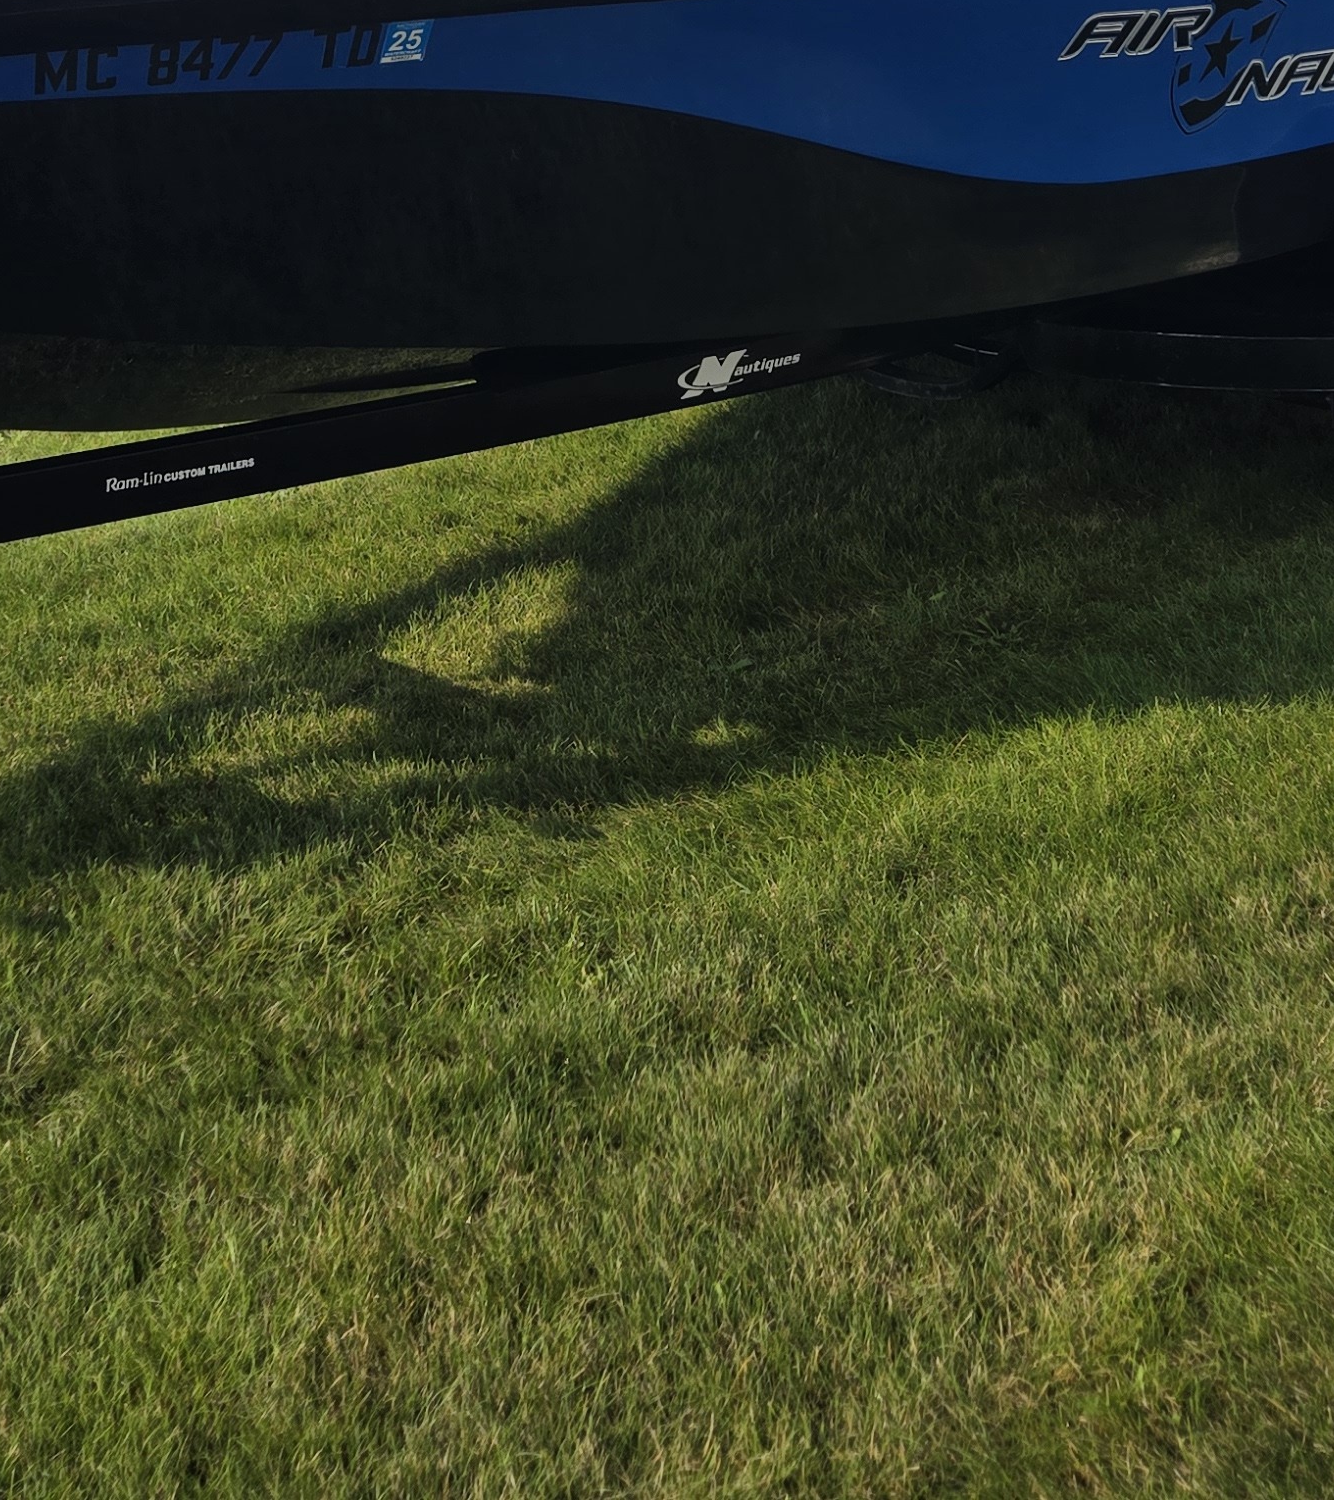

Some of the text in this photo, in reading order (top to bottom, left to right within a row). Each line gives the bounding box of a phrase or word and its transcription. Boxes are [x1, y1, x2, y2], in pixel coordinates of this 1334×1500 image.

[388, 29, 424, 51] 25
[1058, 4, 1215, 61] AIR
[34, 46, 117, 95] MC
[147, 32, 284, 87] 8477
[679, 349, 801, 399] Nautiques
[164, 466, 206, 482] CUSTOM
[208, 457, 255, 474] TRAILERS
